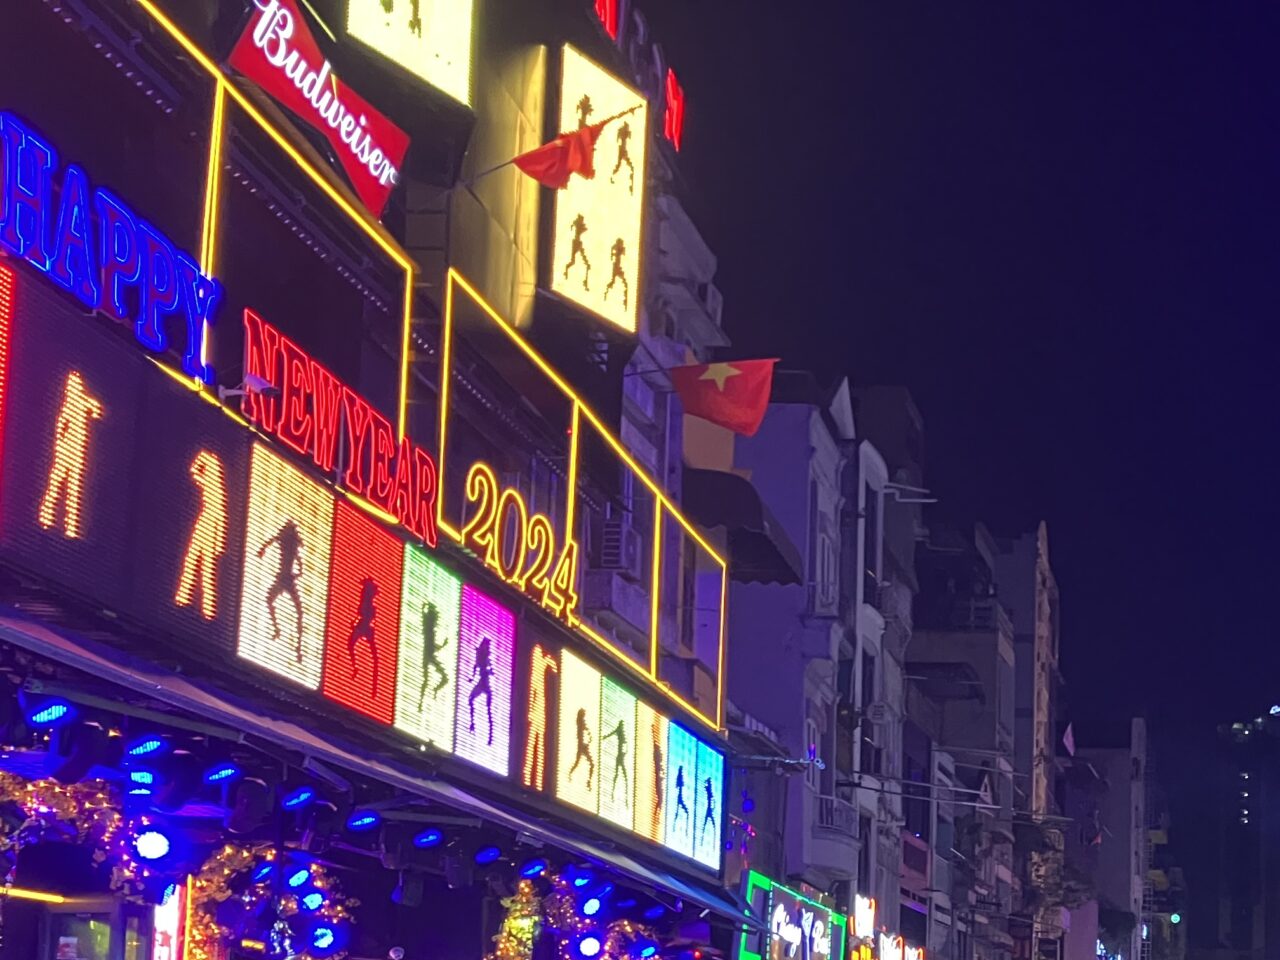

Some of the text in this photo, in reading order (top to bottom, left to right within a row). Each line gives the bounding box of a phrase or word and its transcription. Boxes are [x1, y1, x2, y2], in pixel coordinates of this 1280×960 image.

[253, 0, 398, 187] Budweiser
[0, 112, 224, 384] HAPPY
[461, 462, 579, 617] 2024
